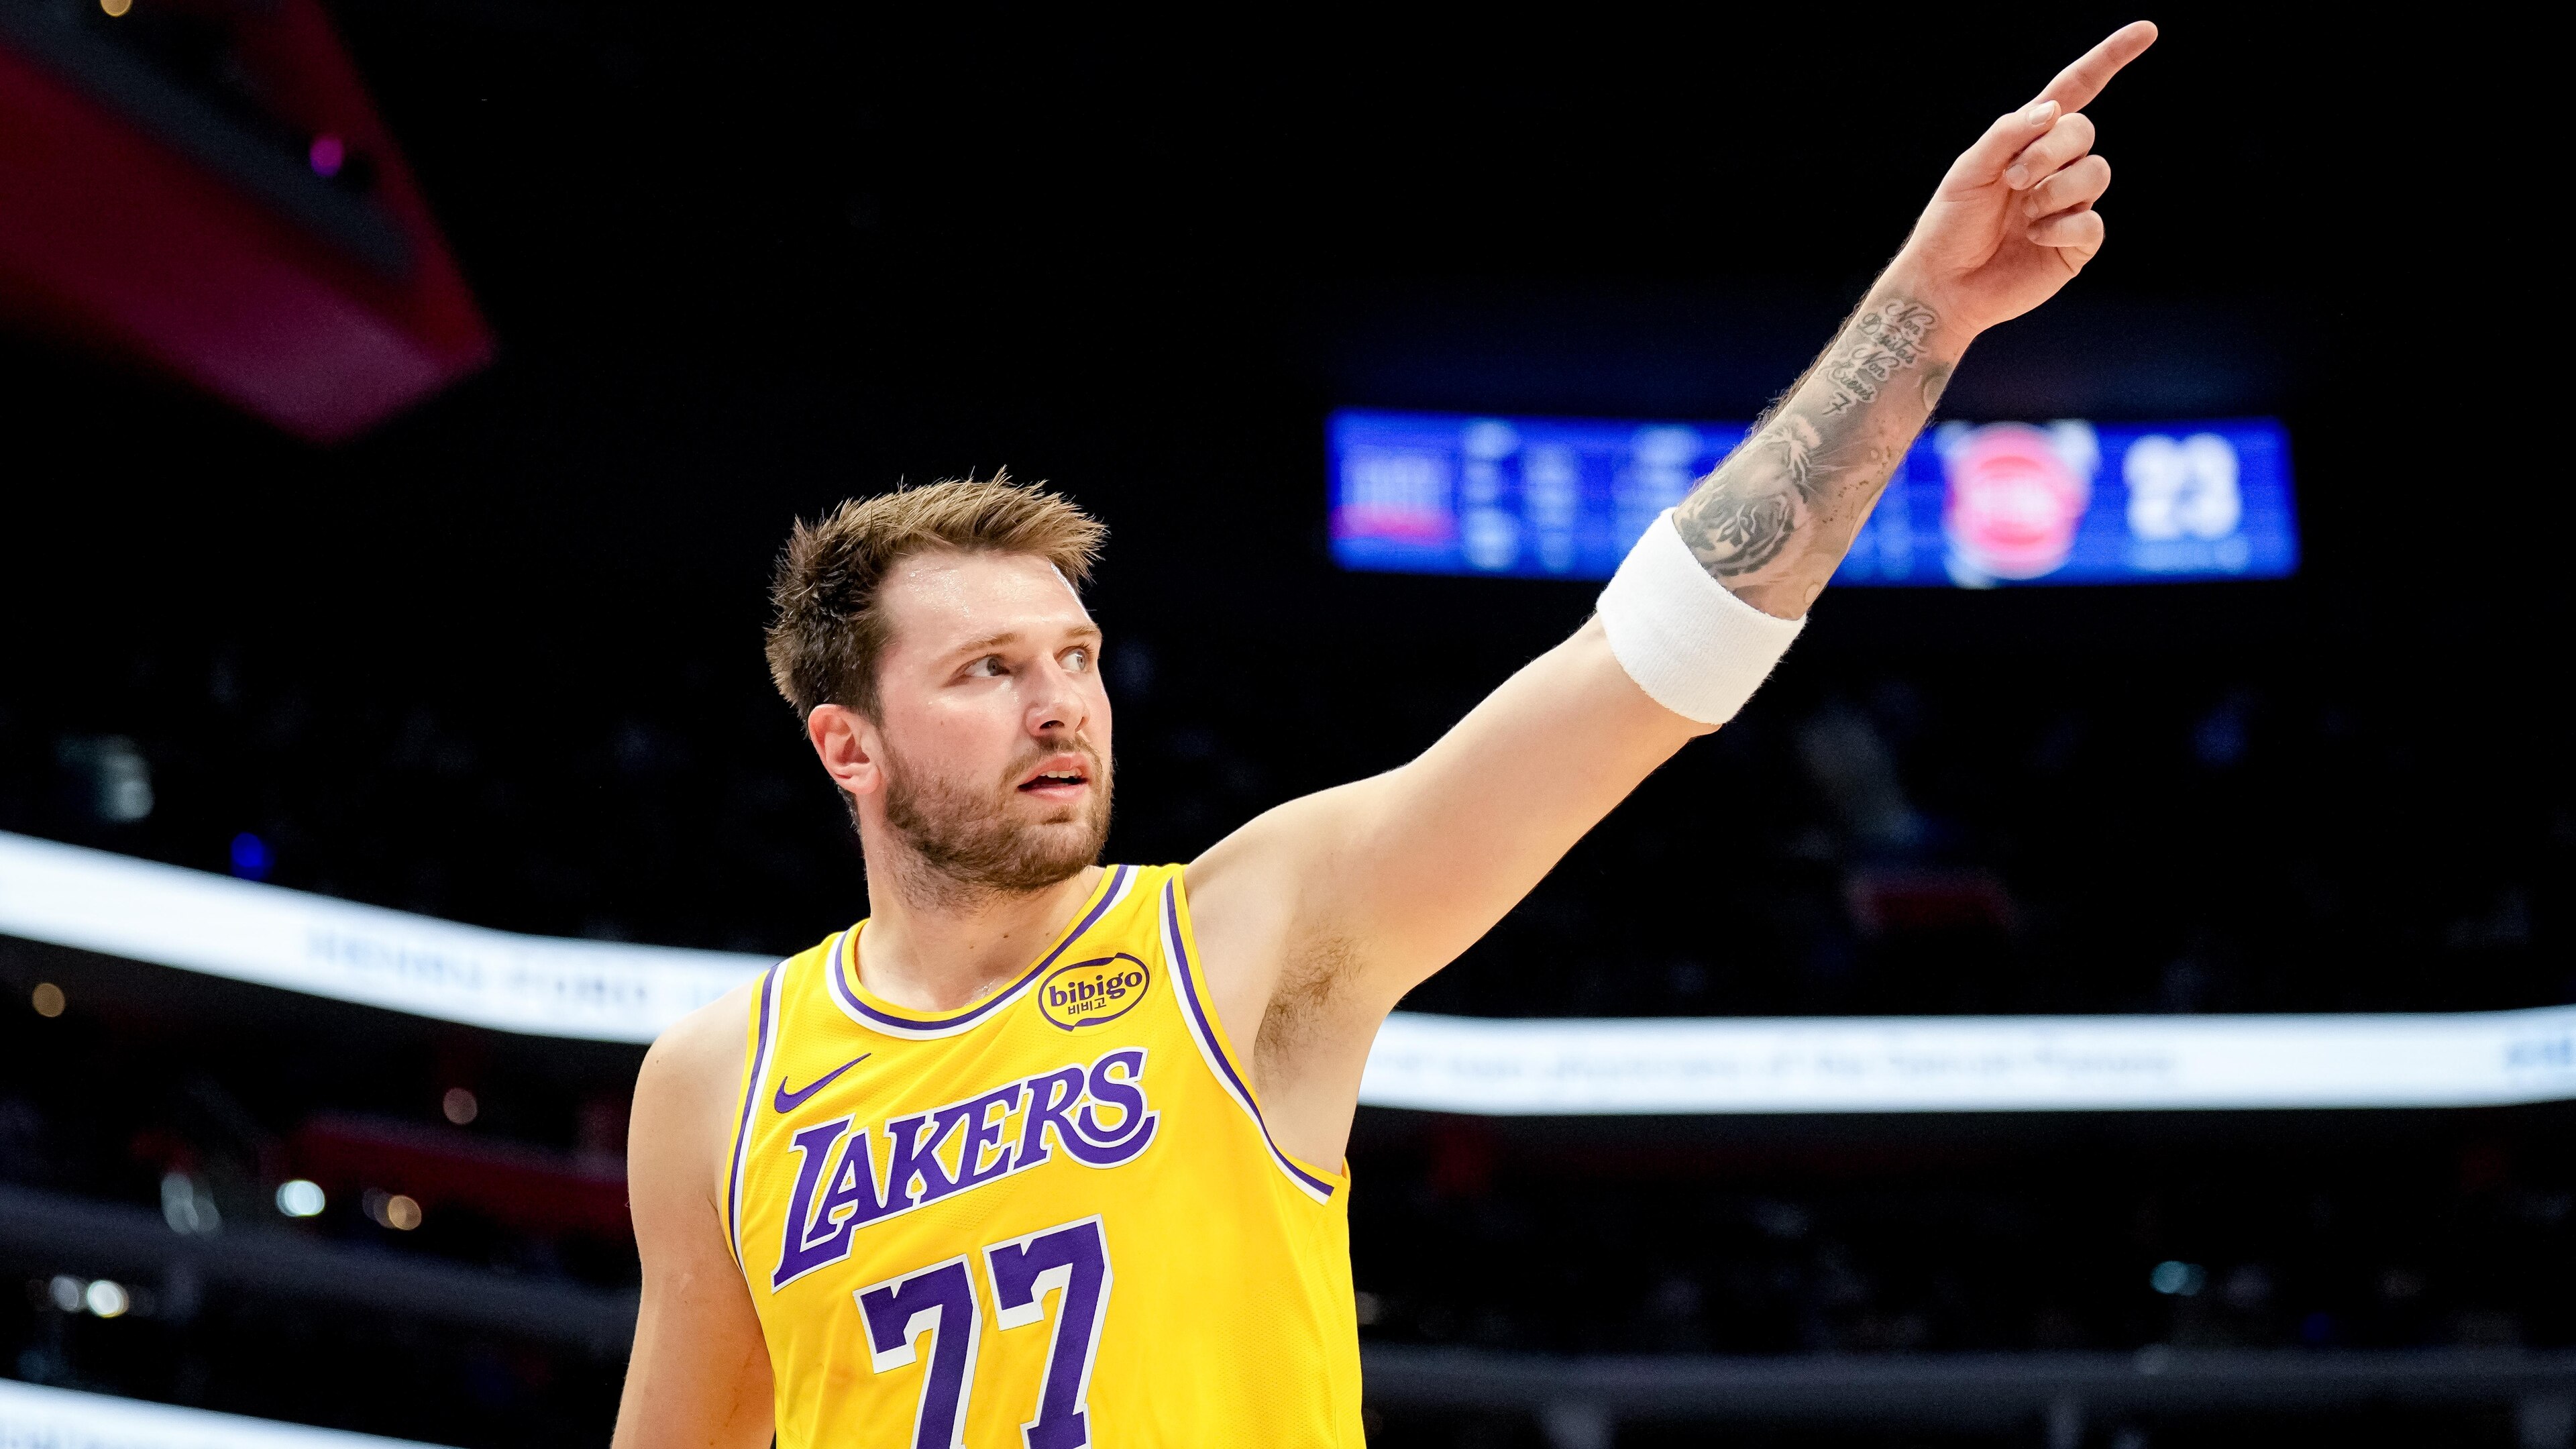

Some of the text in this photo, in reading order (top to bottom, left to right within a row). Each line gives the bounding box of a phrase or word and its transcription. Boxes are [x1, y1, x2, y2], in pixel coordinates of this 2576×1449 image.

[1885, 303, 1935, 335] Non
[1851, 347, 1900, 378] Non
[1822, 392, 1851, 415] 7
[1049, 971, 1143, 1007] bibigo
[1067, 997, 1107, 1016] 비비고
[771, 1046, 1161, 1294] LAKERS
[853, 1214, 1114, 1449] 77
